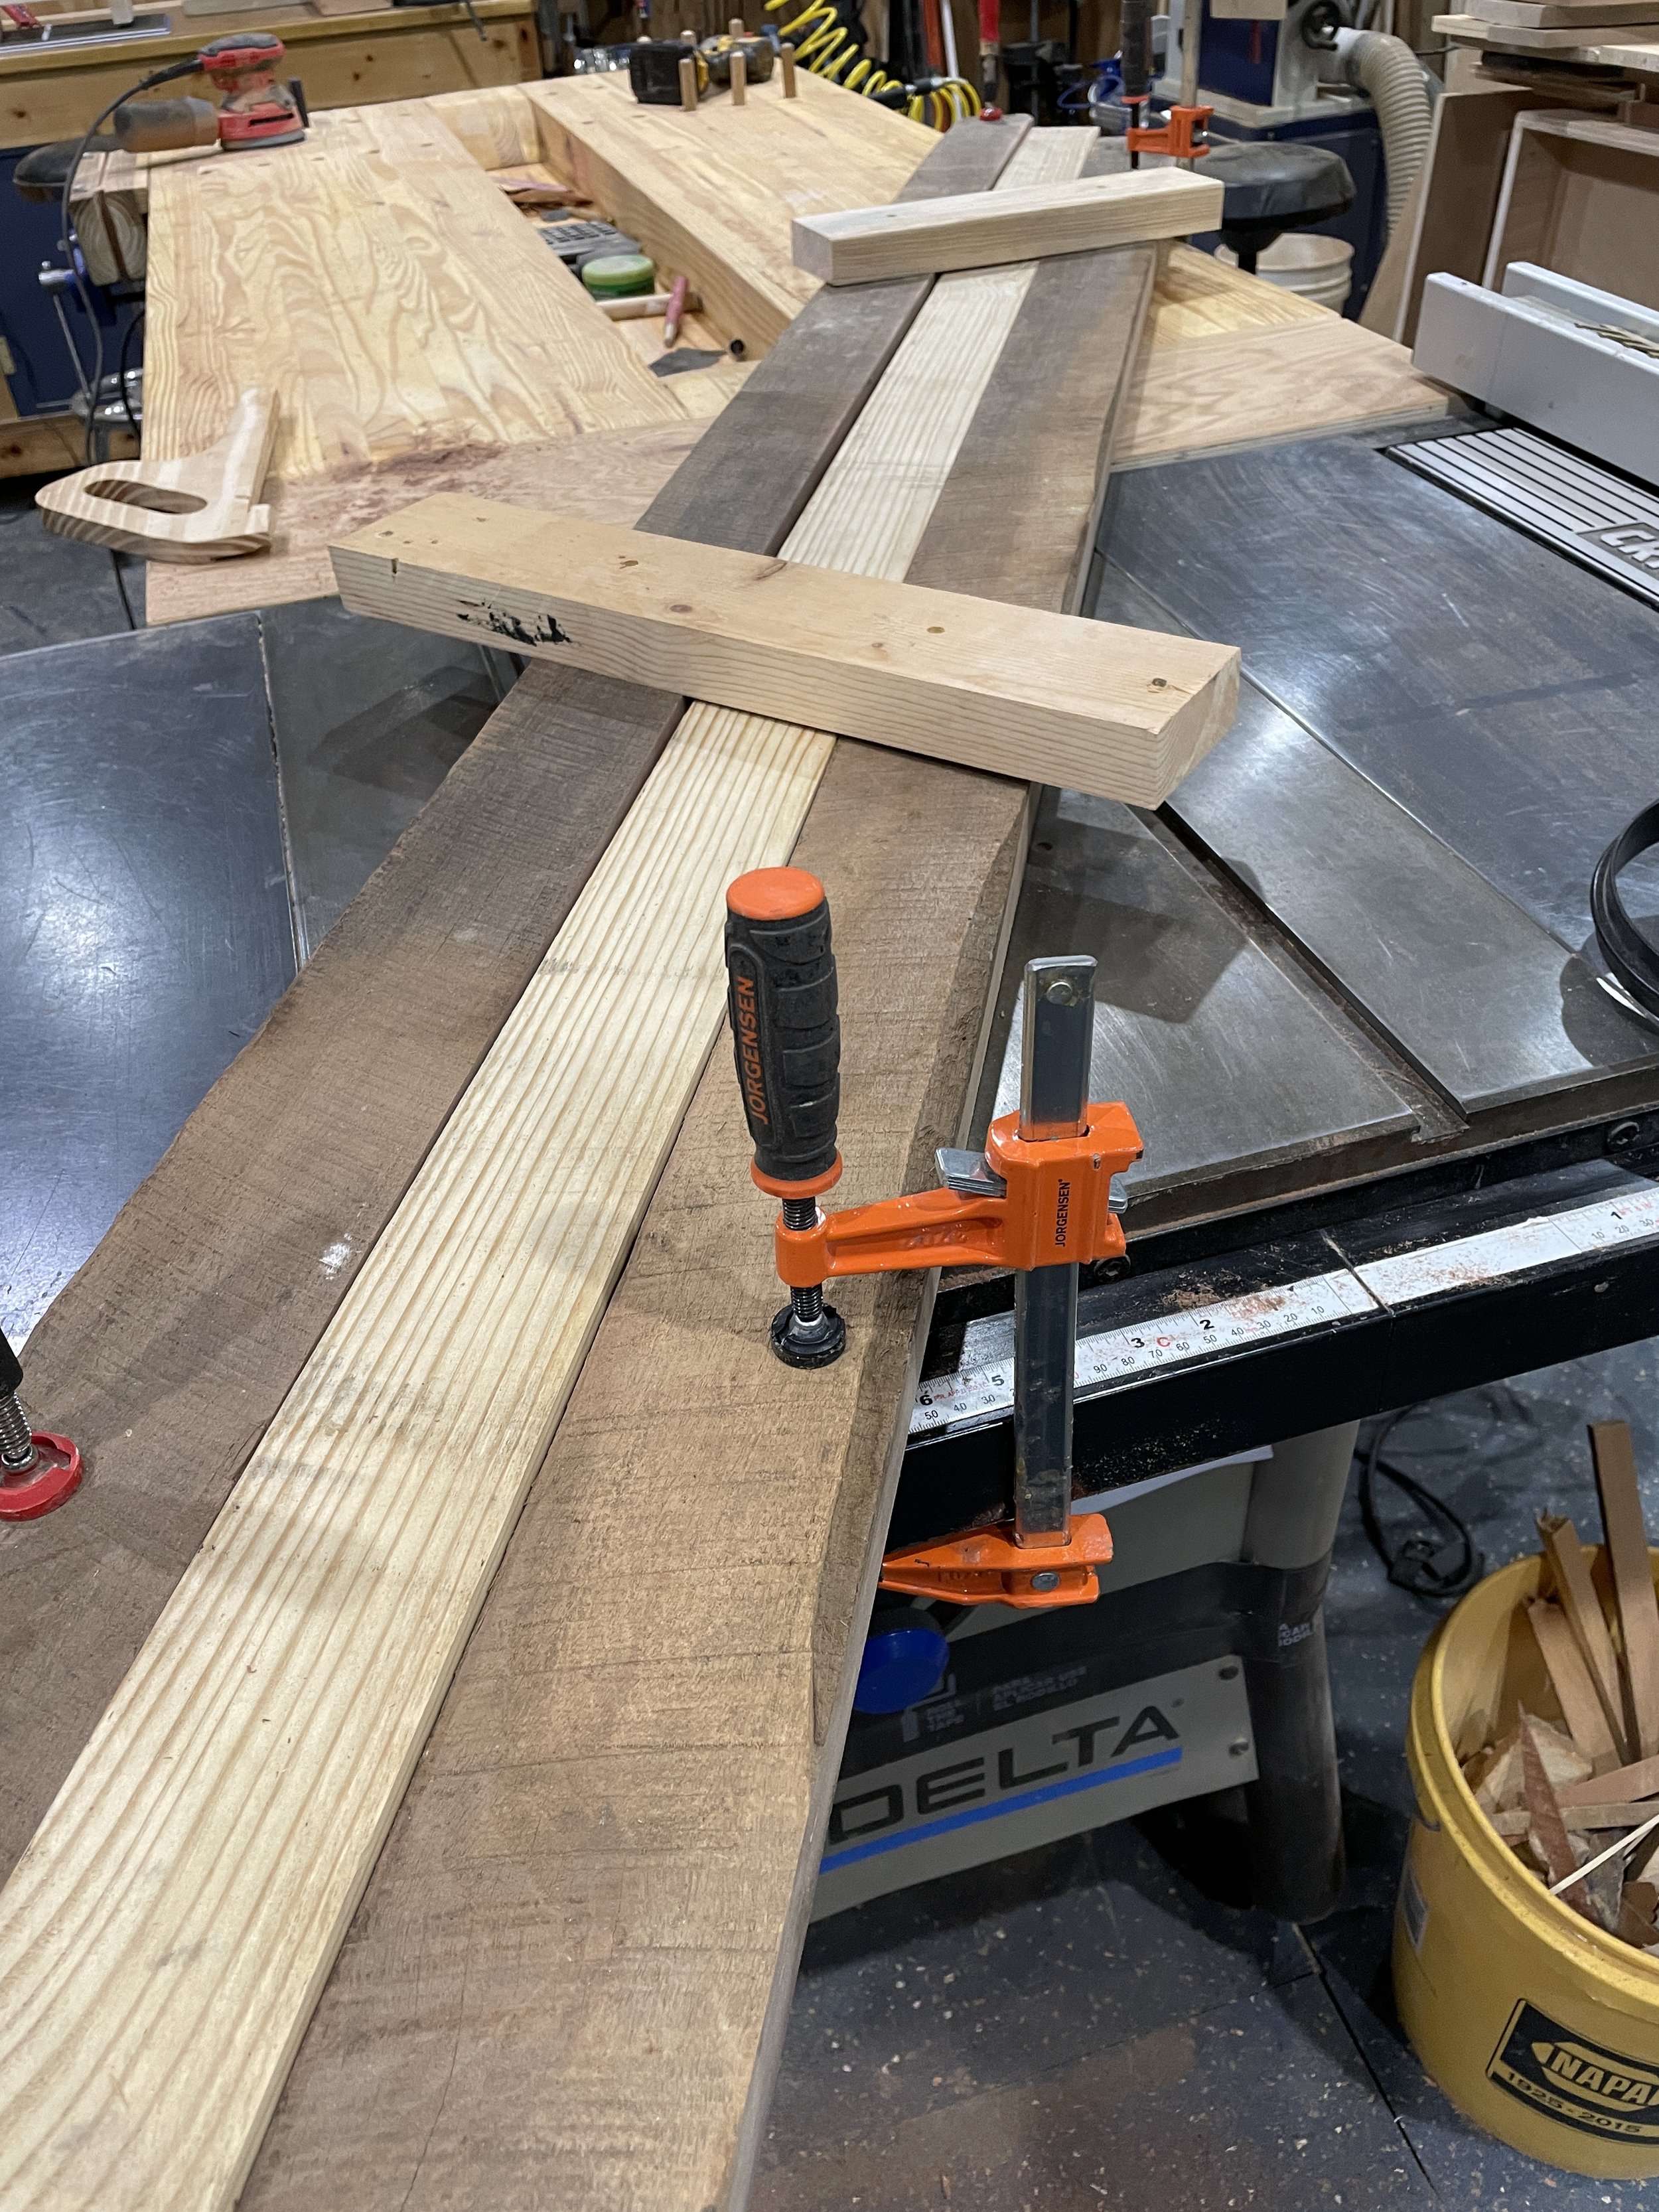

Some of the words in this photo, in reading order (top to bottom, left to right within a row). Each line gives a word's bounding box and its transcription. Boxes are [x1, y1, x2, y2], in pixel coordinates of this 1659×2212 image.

[736, 975, 769, 1126] JORGENSEN
[1054, 1181, 1071, 1248] JORGENSEN
[919, 1394, 934, 1406] 6
[991, 1374, 1005, 1386] 5
[1131, 1337, 1145, 1349] 3
[1199, 1319, 1215, 1331] 2
[924, 1410, 939, 1420] 50
[953, 1402, 968, 1412] 40
[981, 1394, 996, 1405] 30
[1093, 1364, 1108, 1374] 90
[1121, 1356, 1135, 1366] 80
[1148, 1349, 1163, 1359] 70
[1176, 1341, 1190, 1351] 60
[1202, 1334, 1218, 1344] 50
[1230, 1327, 1245, 1336] 40
[1256, 1319, 1271, 1329] 30
[1283, 1312, 1298, 1323] 20
[1311, 1305, 1325, 1315] 10
[830, 1706, 1180, 1845] DELTA
[1551, 2050, 1652, 2105] NAPA
